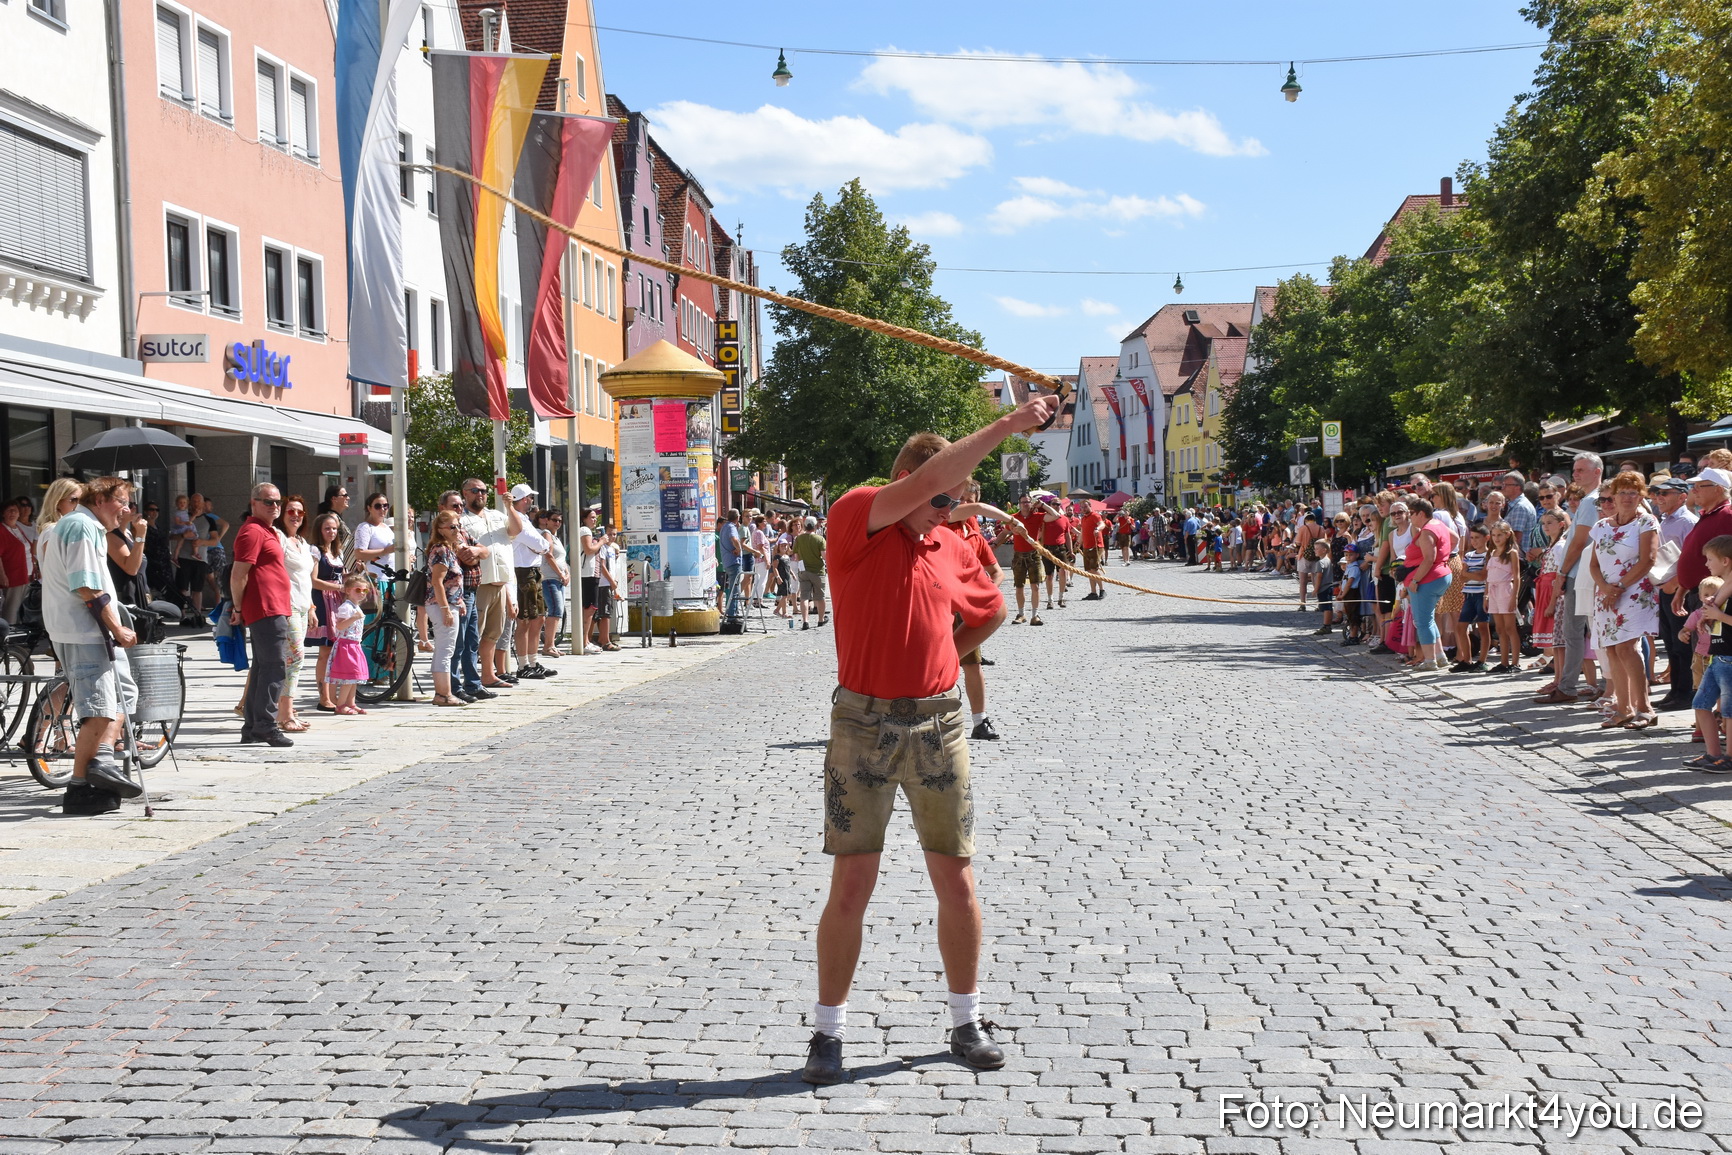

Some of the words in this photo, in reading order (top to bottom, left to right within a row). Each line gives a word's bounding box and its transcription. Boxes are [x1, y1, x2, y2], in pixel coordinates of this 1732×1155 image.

[143, 338, 204, 357] sutor.
[230, 339, 293, 389] sutor.
[718, 323, 739, 432] HOTEL
